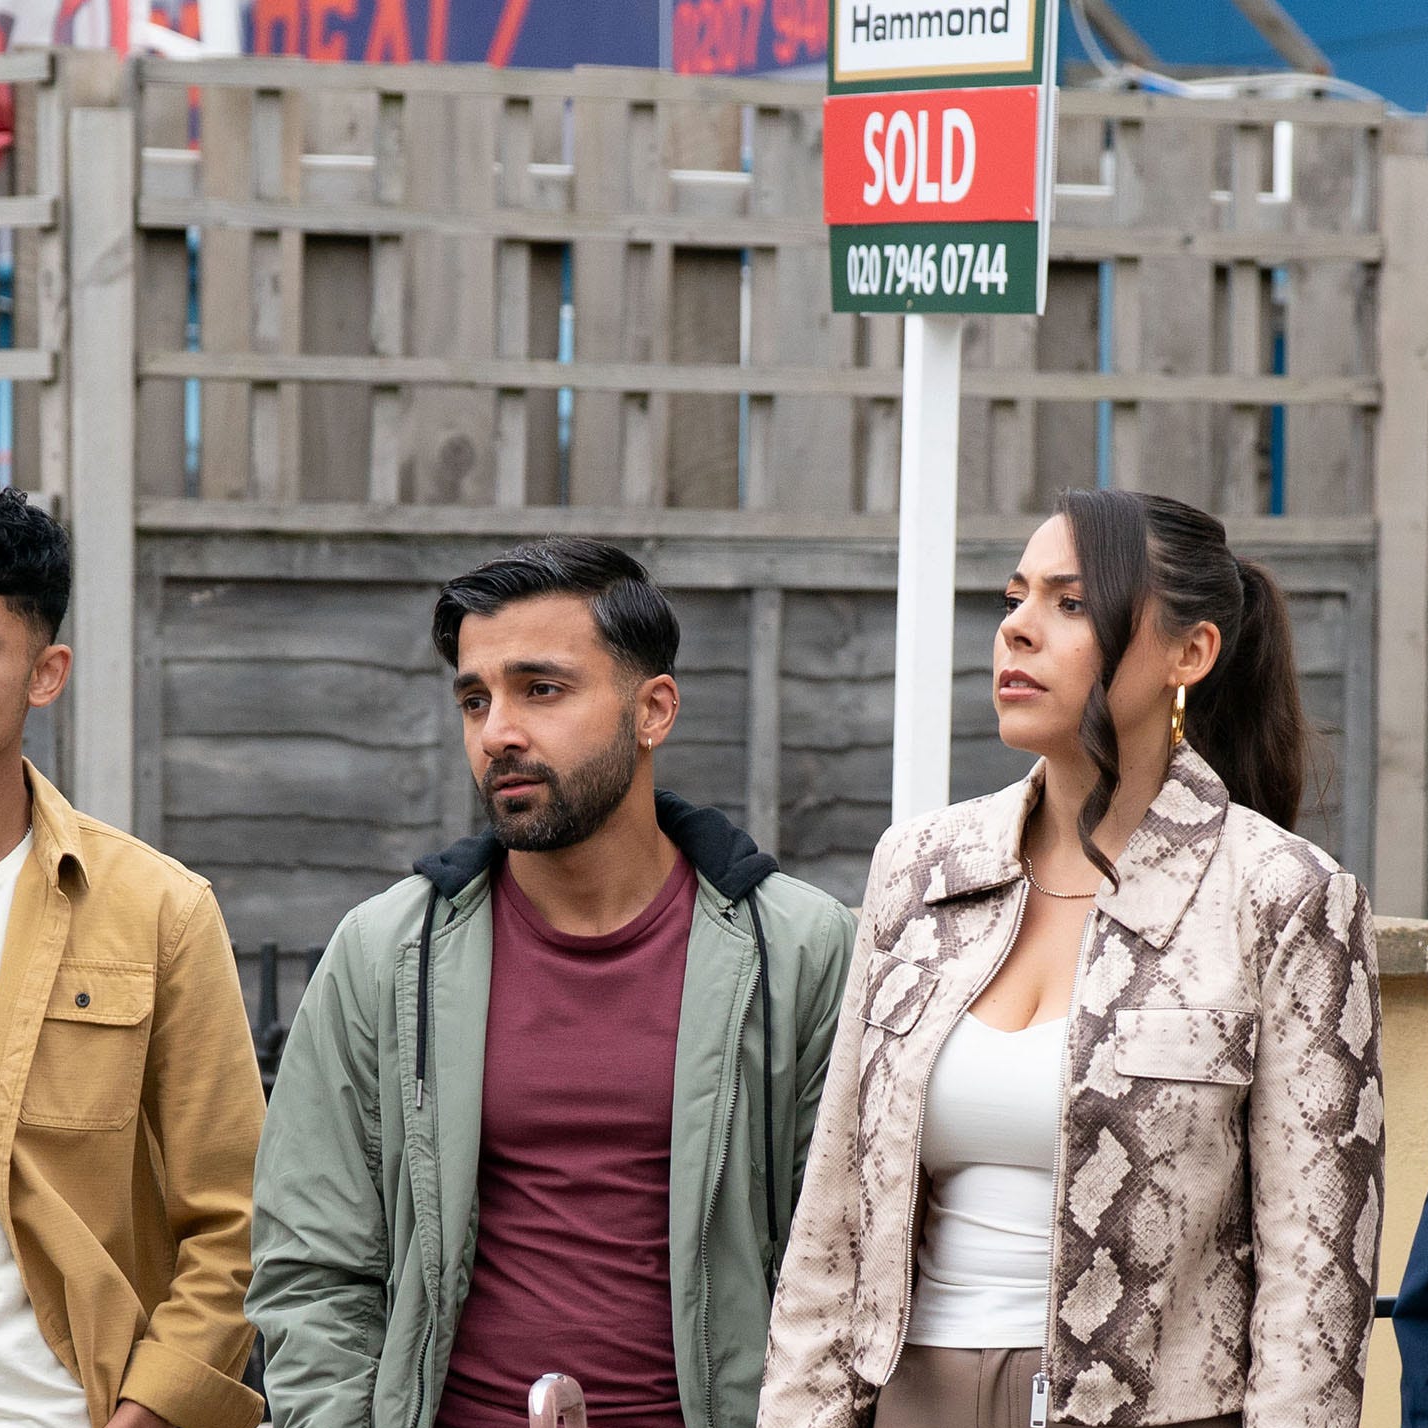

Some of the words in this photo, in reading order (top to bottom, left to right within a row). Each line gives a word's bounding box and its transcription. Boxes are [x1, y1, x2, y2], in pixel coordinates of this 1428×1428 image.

[852, 0, 1010, 43] Hammond
[863, 108, 976, 206] SOLD
[847, 244, 882, 296] 020
[883, 243, 938, 296] 7946
[941, 243, 1008, 296] 0744
